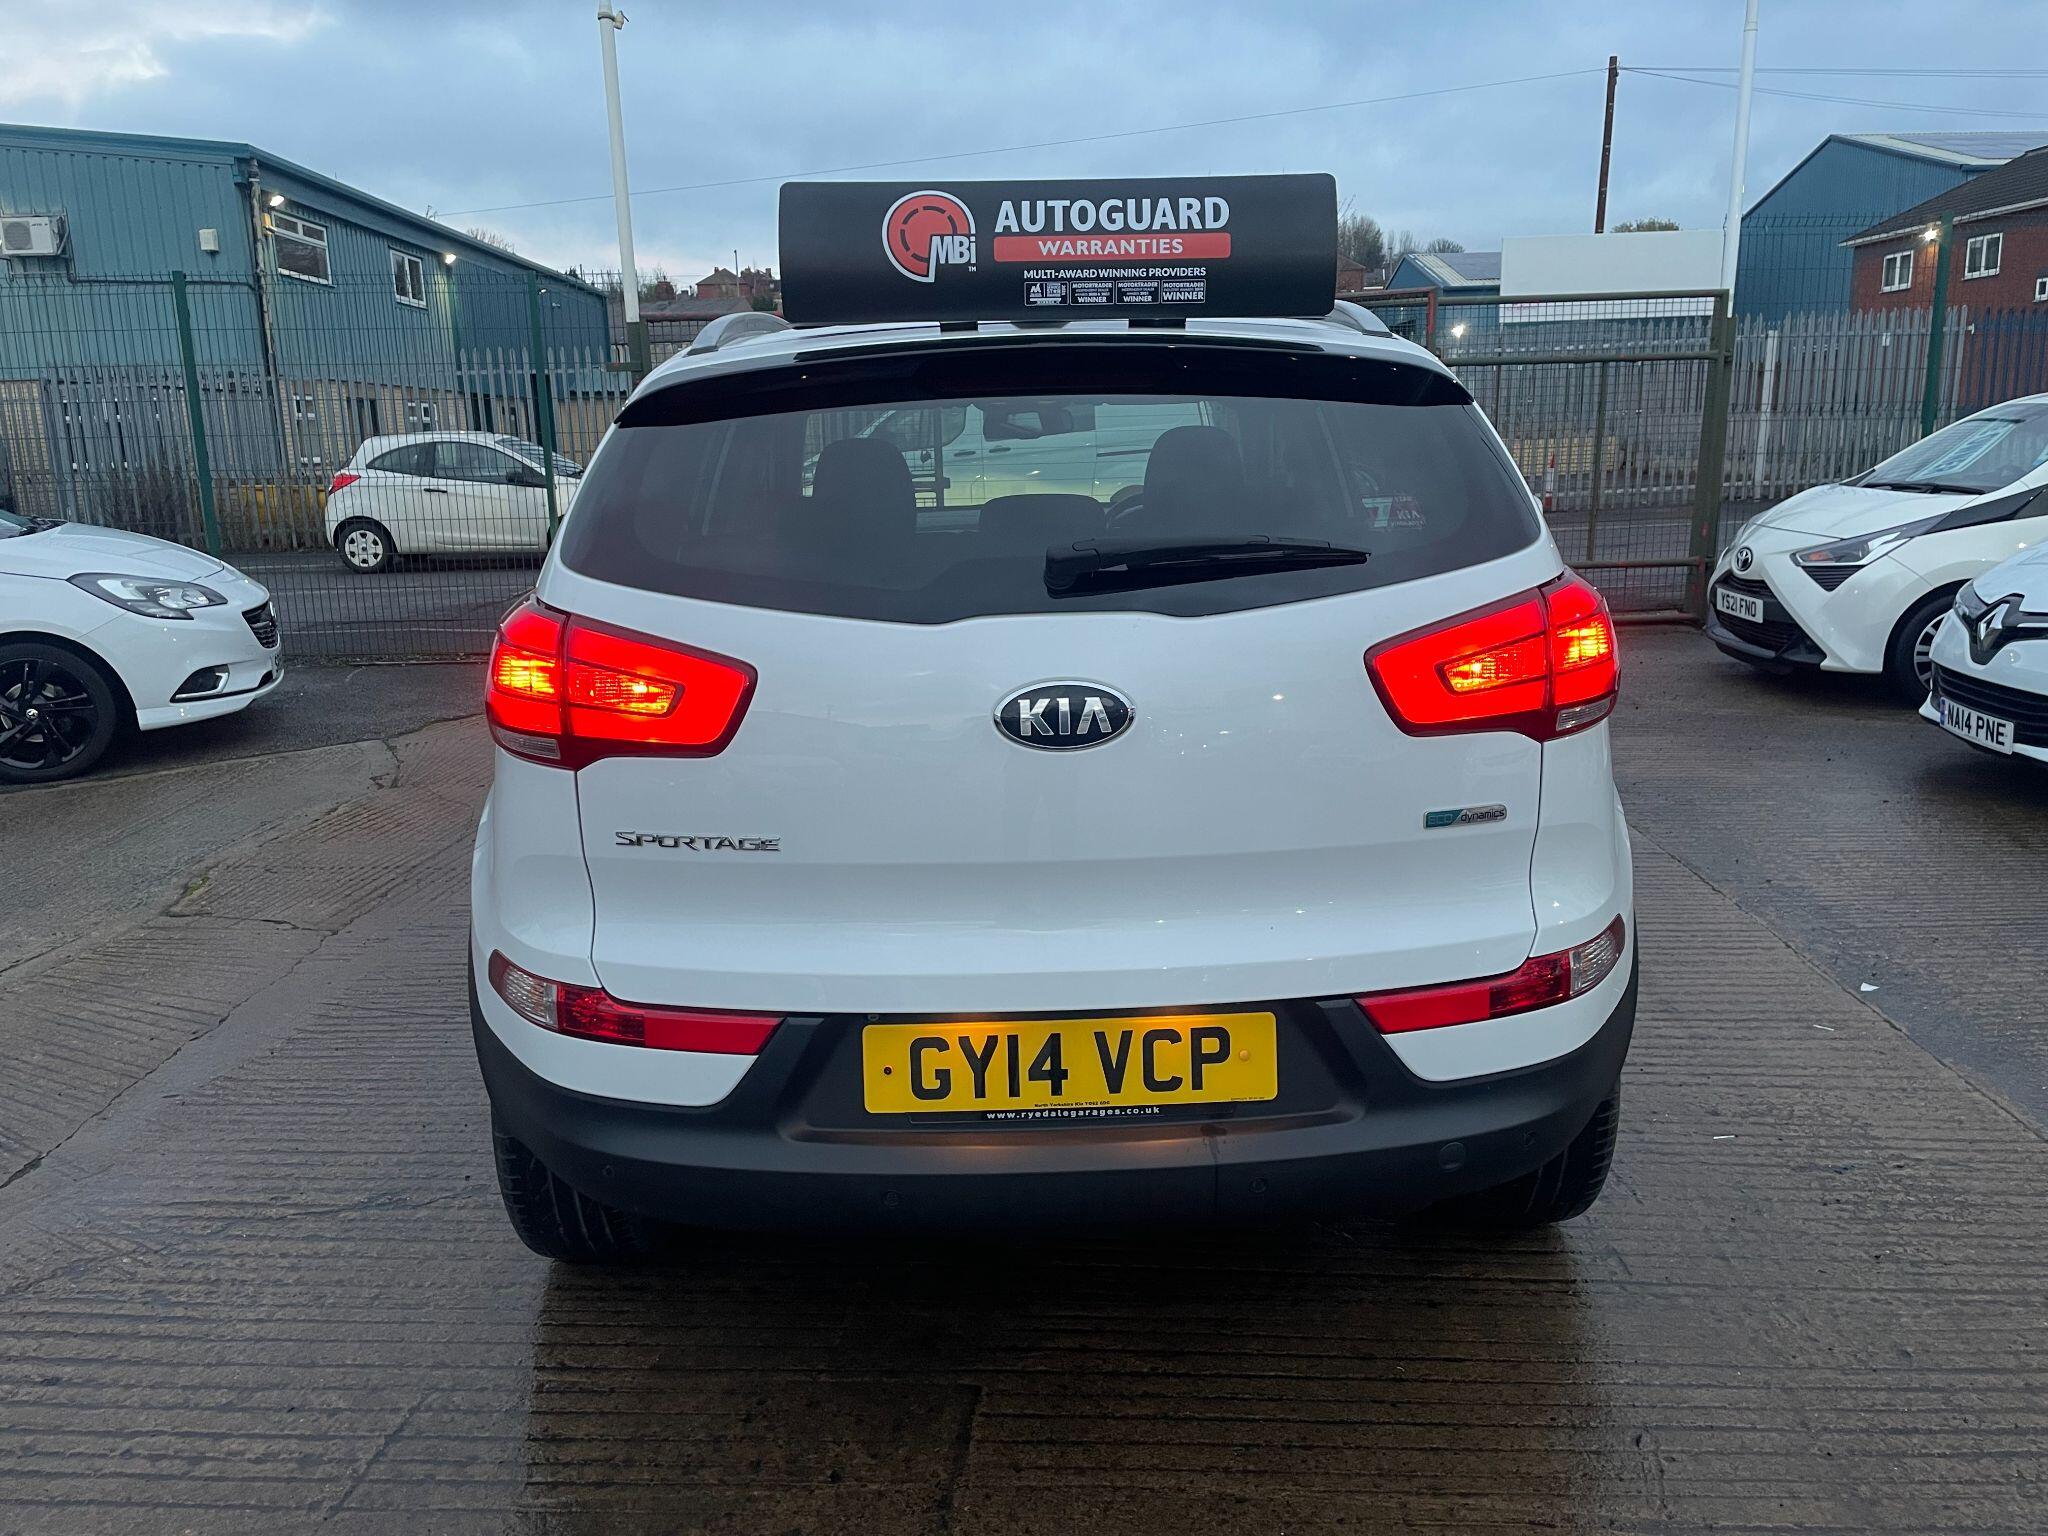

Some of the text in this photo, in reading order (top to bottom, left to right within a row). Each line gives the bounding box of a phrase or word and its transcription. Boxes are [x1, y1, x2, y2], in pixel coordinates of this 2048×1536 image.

[995, 197, 1230, 232] AUTOGUARD
[1038, 239, 1183, 256] WARRANTIES
[1024, 268, 1206, 279] MULTI-AWARD WINNING PROVIDERS
[1163, 292, 1204, 300] WINNER
[1018, 697, 1112, 736] KIA
[1947, 703, 2006, 747] NA14 PNE
[1460, 809, 1505, 823] dynamics
[615, 831, 781, 851] SPORTAGE
[909, 1026, 1231, 1101] GY14 VCP
[986, 1107, 1160, 1119] www.ryedalegarages.co.uk
